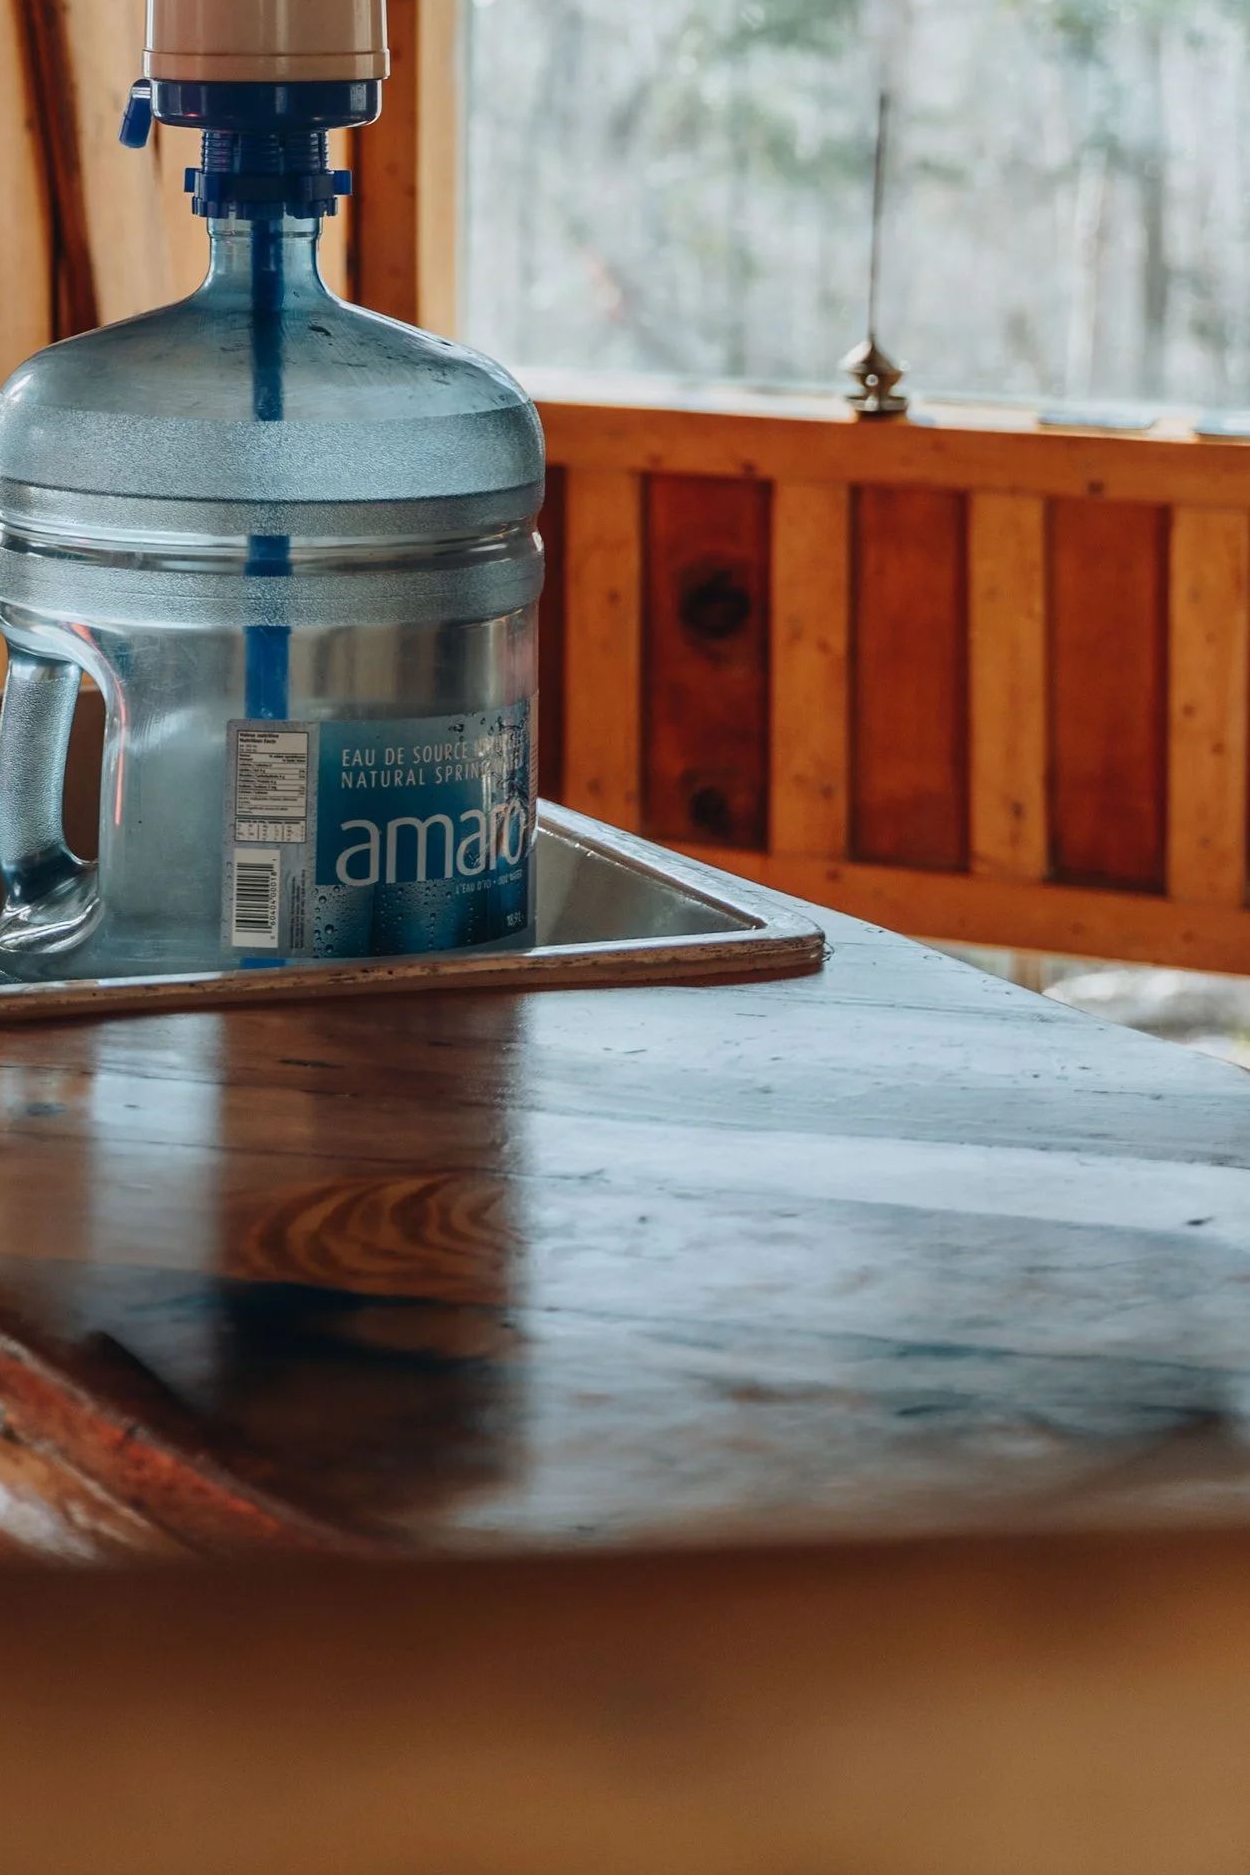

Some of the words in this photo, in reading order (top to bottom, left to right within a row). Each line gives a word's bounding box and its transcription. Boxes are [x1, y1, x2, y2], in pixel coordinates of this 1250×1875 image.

[341, 748, 376, 767] EAU
[384, 747, 406, 766] DE
[413, 743, 468, 763] SOURCE
[341, 768, 426, 789] NATURAL
[434, 760, 491, 784] SPRING
[335, 798, 527, 887] amaro
